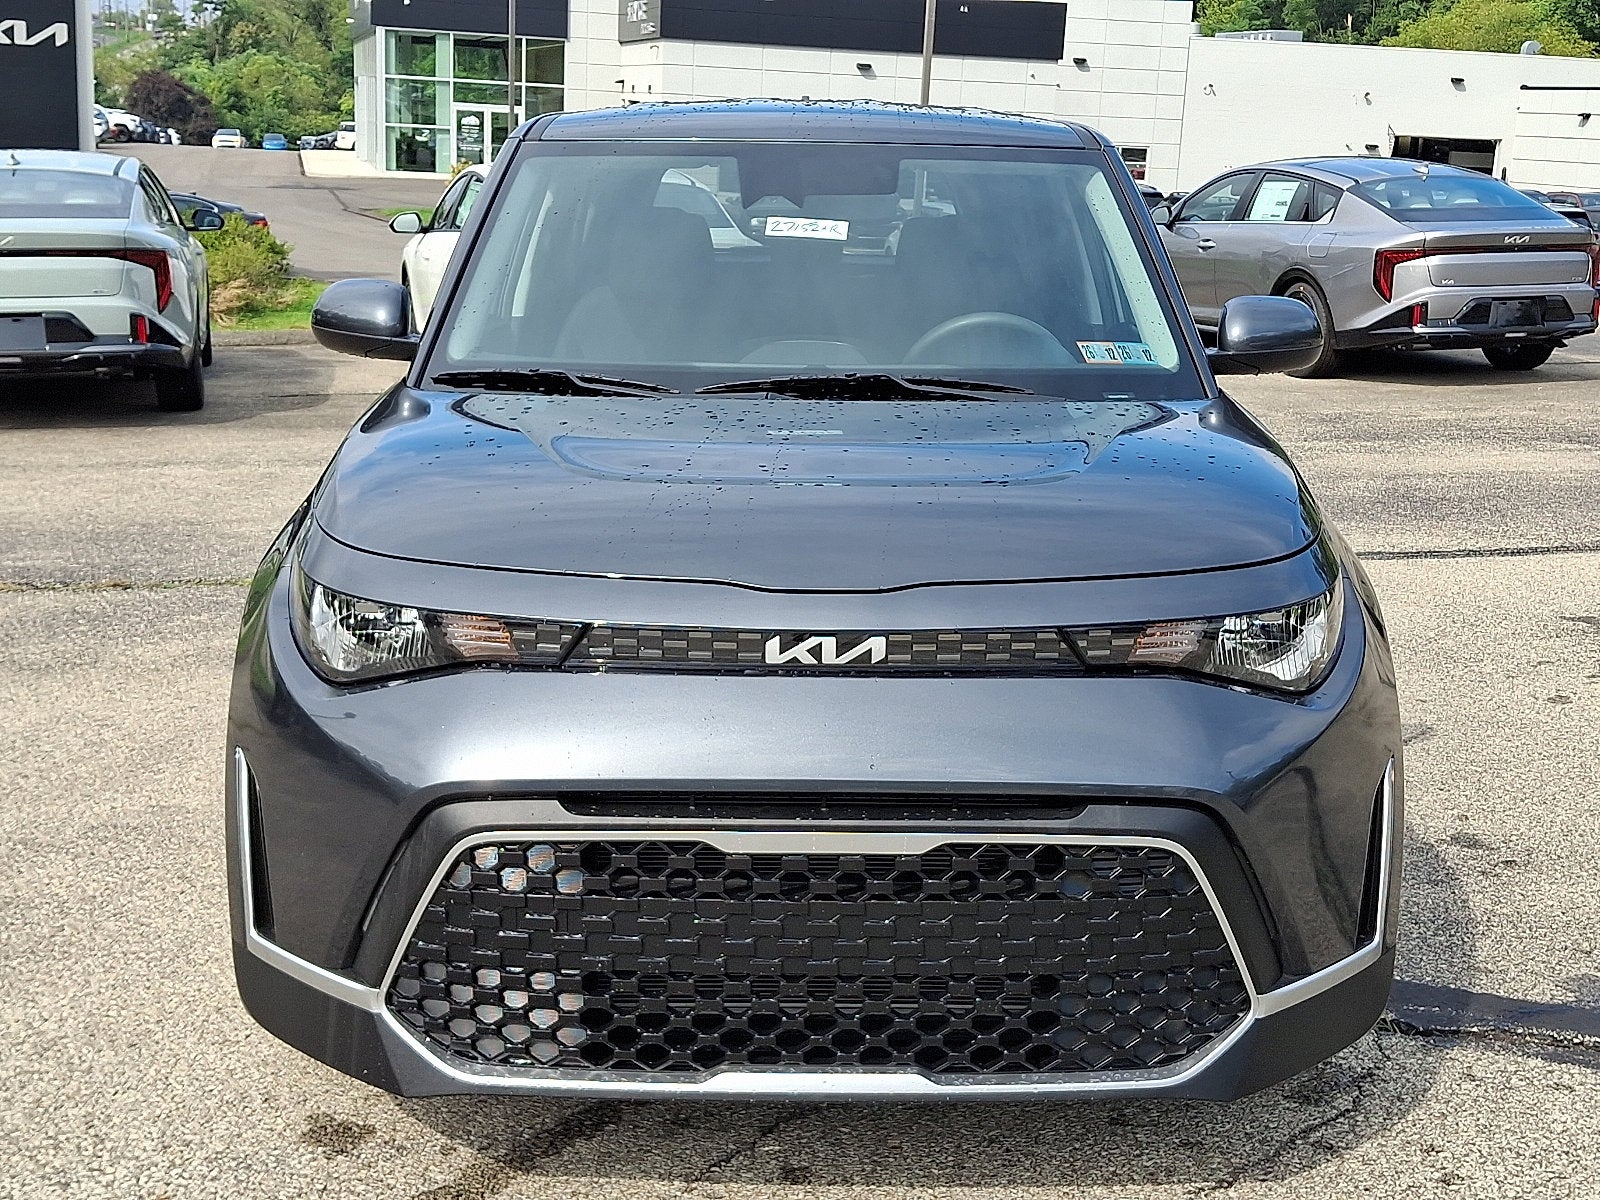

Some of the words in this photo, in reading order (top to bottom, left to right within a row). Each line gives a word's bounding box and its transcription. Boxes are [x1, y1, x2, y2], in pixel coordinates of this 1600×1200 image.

[1081, 344, 1096, 359] 26
[1104, 347, 1118, 361] 12
[1118, 345, 1132, 360] 26
[1141, 348, 1155, 362] 12
[765, 635, 887, 665] KIA
